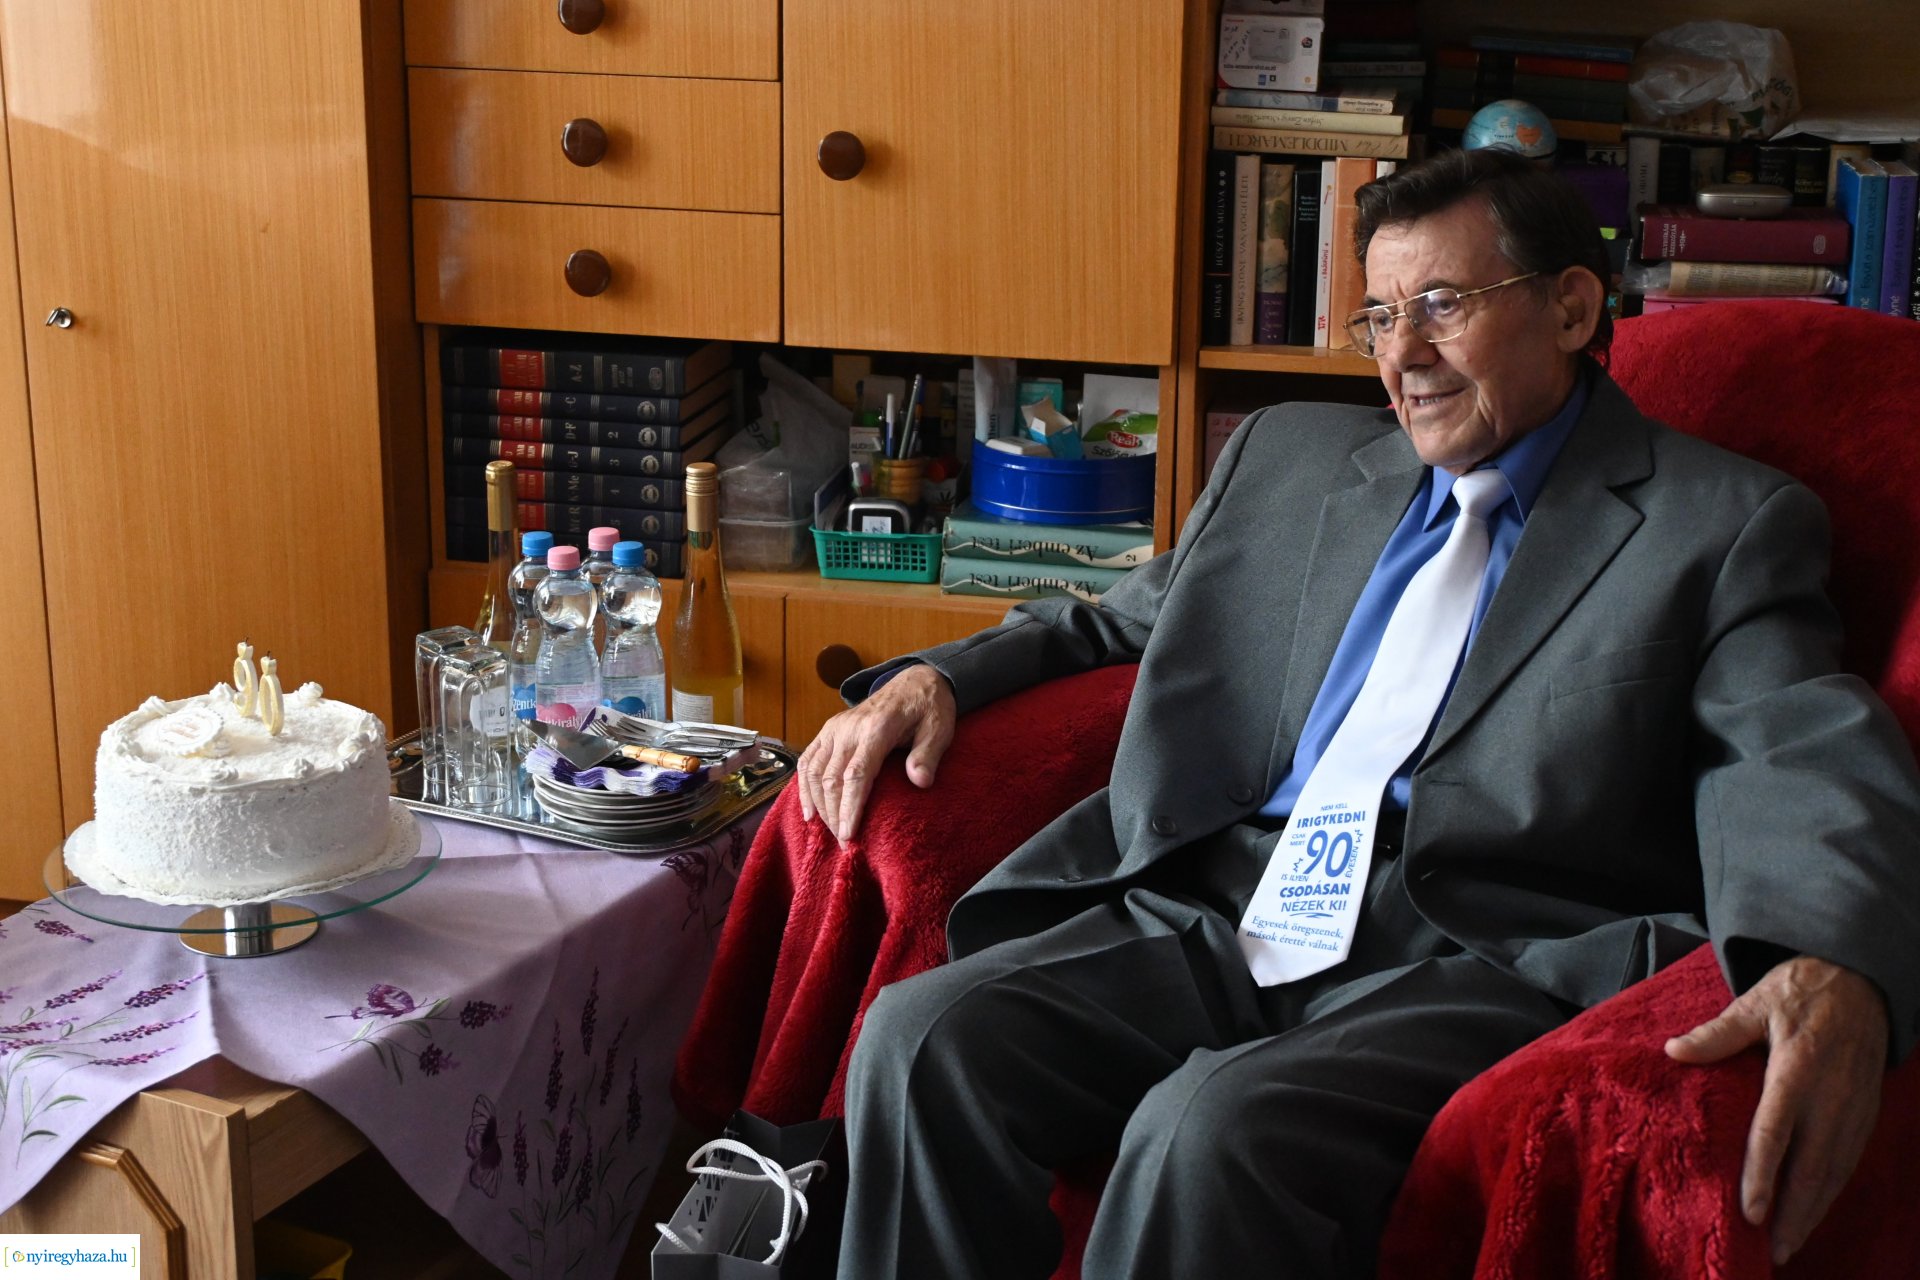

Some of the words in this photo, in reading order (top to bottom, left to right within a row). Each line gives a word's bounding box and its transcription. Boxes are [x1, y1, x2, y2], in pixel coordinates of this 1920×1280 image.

[1229, 133, 1350, 152] MIDDLEMARCH
[1213, 283, 1223, 319] DUMAS
[970, 535, 999, 549] test
[1009, 538, 1071, 558] emberi
[1075, 544, 1099, 561] Az
[1125, 554, 1137, 562] 2
[969, 573, 999, 586] test
[1008, 575, 1069, 594] emberi
[1074, 580, 1097, 598] Az
[1297, 811, 1366, 828] IRIGYKEDNI
[1302, 829, 1353, 878] 90
[1345, 846, 1359, 878] ÉVESEN
[1289, 874, 1309, 882] ILYEN
[1279, 880, 1351, 898] CSODÁSAN
[1280, 898, 1326, 912] NÉZEK
[1328, 900, 1347, 911] KI!
[1251, 915, 1288, 931] Egyesek
[1291, 923, 1344, 939] öregszenek,
[1246, 930, 1277, 942] mások
[1279, 934, 1306, 947] éretté
[1308, 939, 1339, 952] válnak
